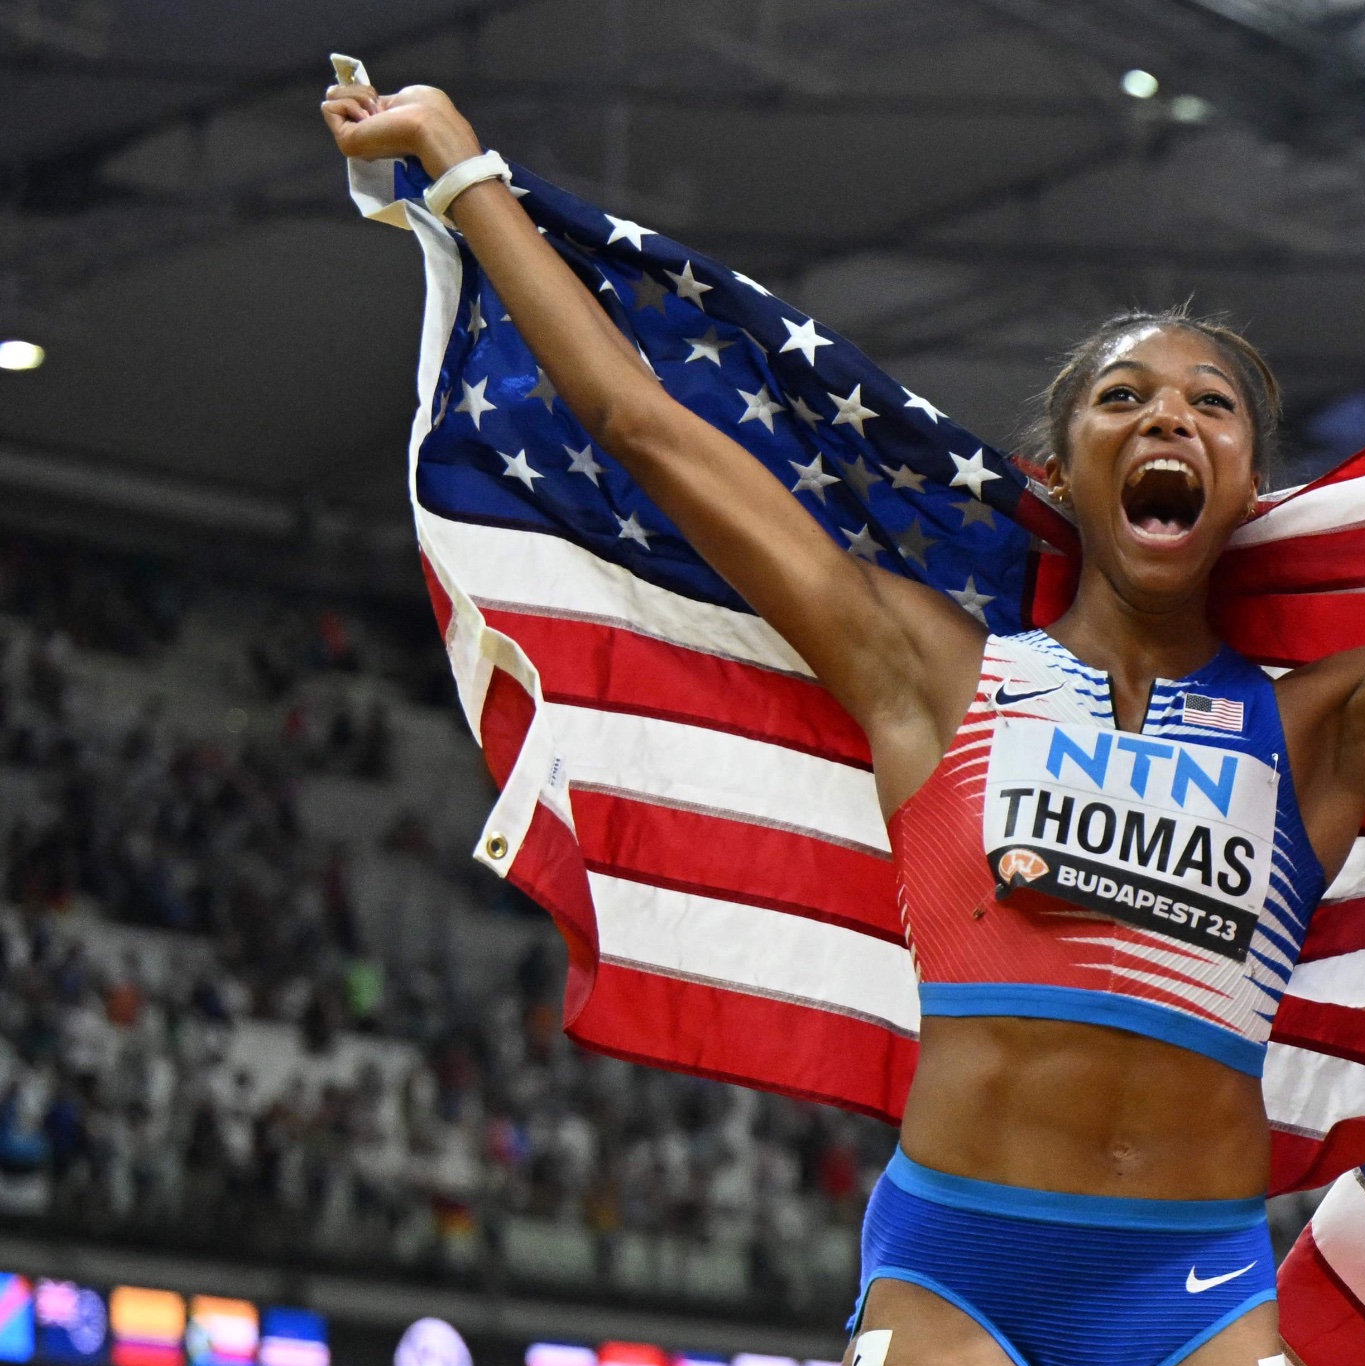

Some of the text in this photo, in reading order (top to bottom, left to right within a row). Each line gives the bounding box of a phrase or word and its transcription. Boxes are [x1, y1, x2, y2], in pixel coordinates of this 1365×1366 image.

[1045, 726, 1239, 817] NTN
[999, 787, 1255, 897] THOMAS
[1056, 865, 1237, 942] BUDAPEST 23
